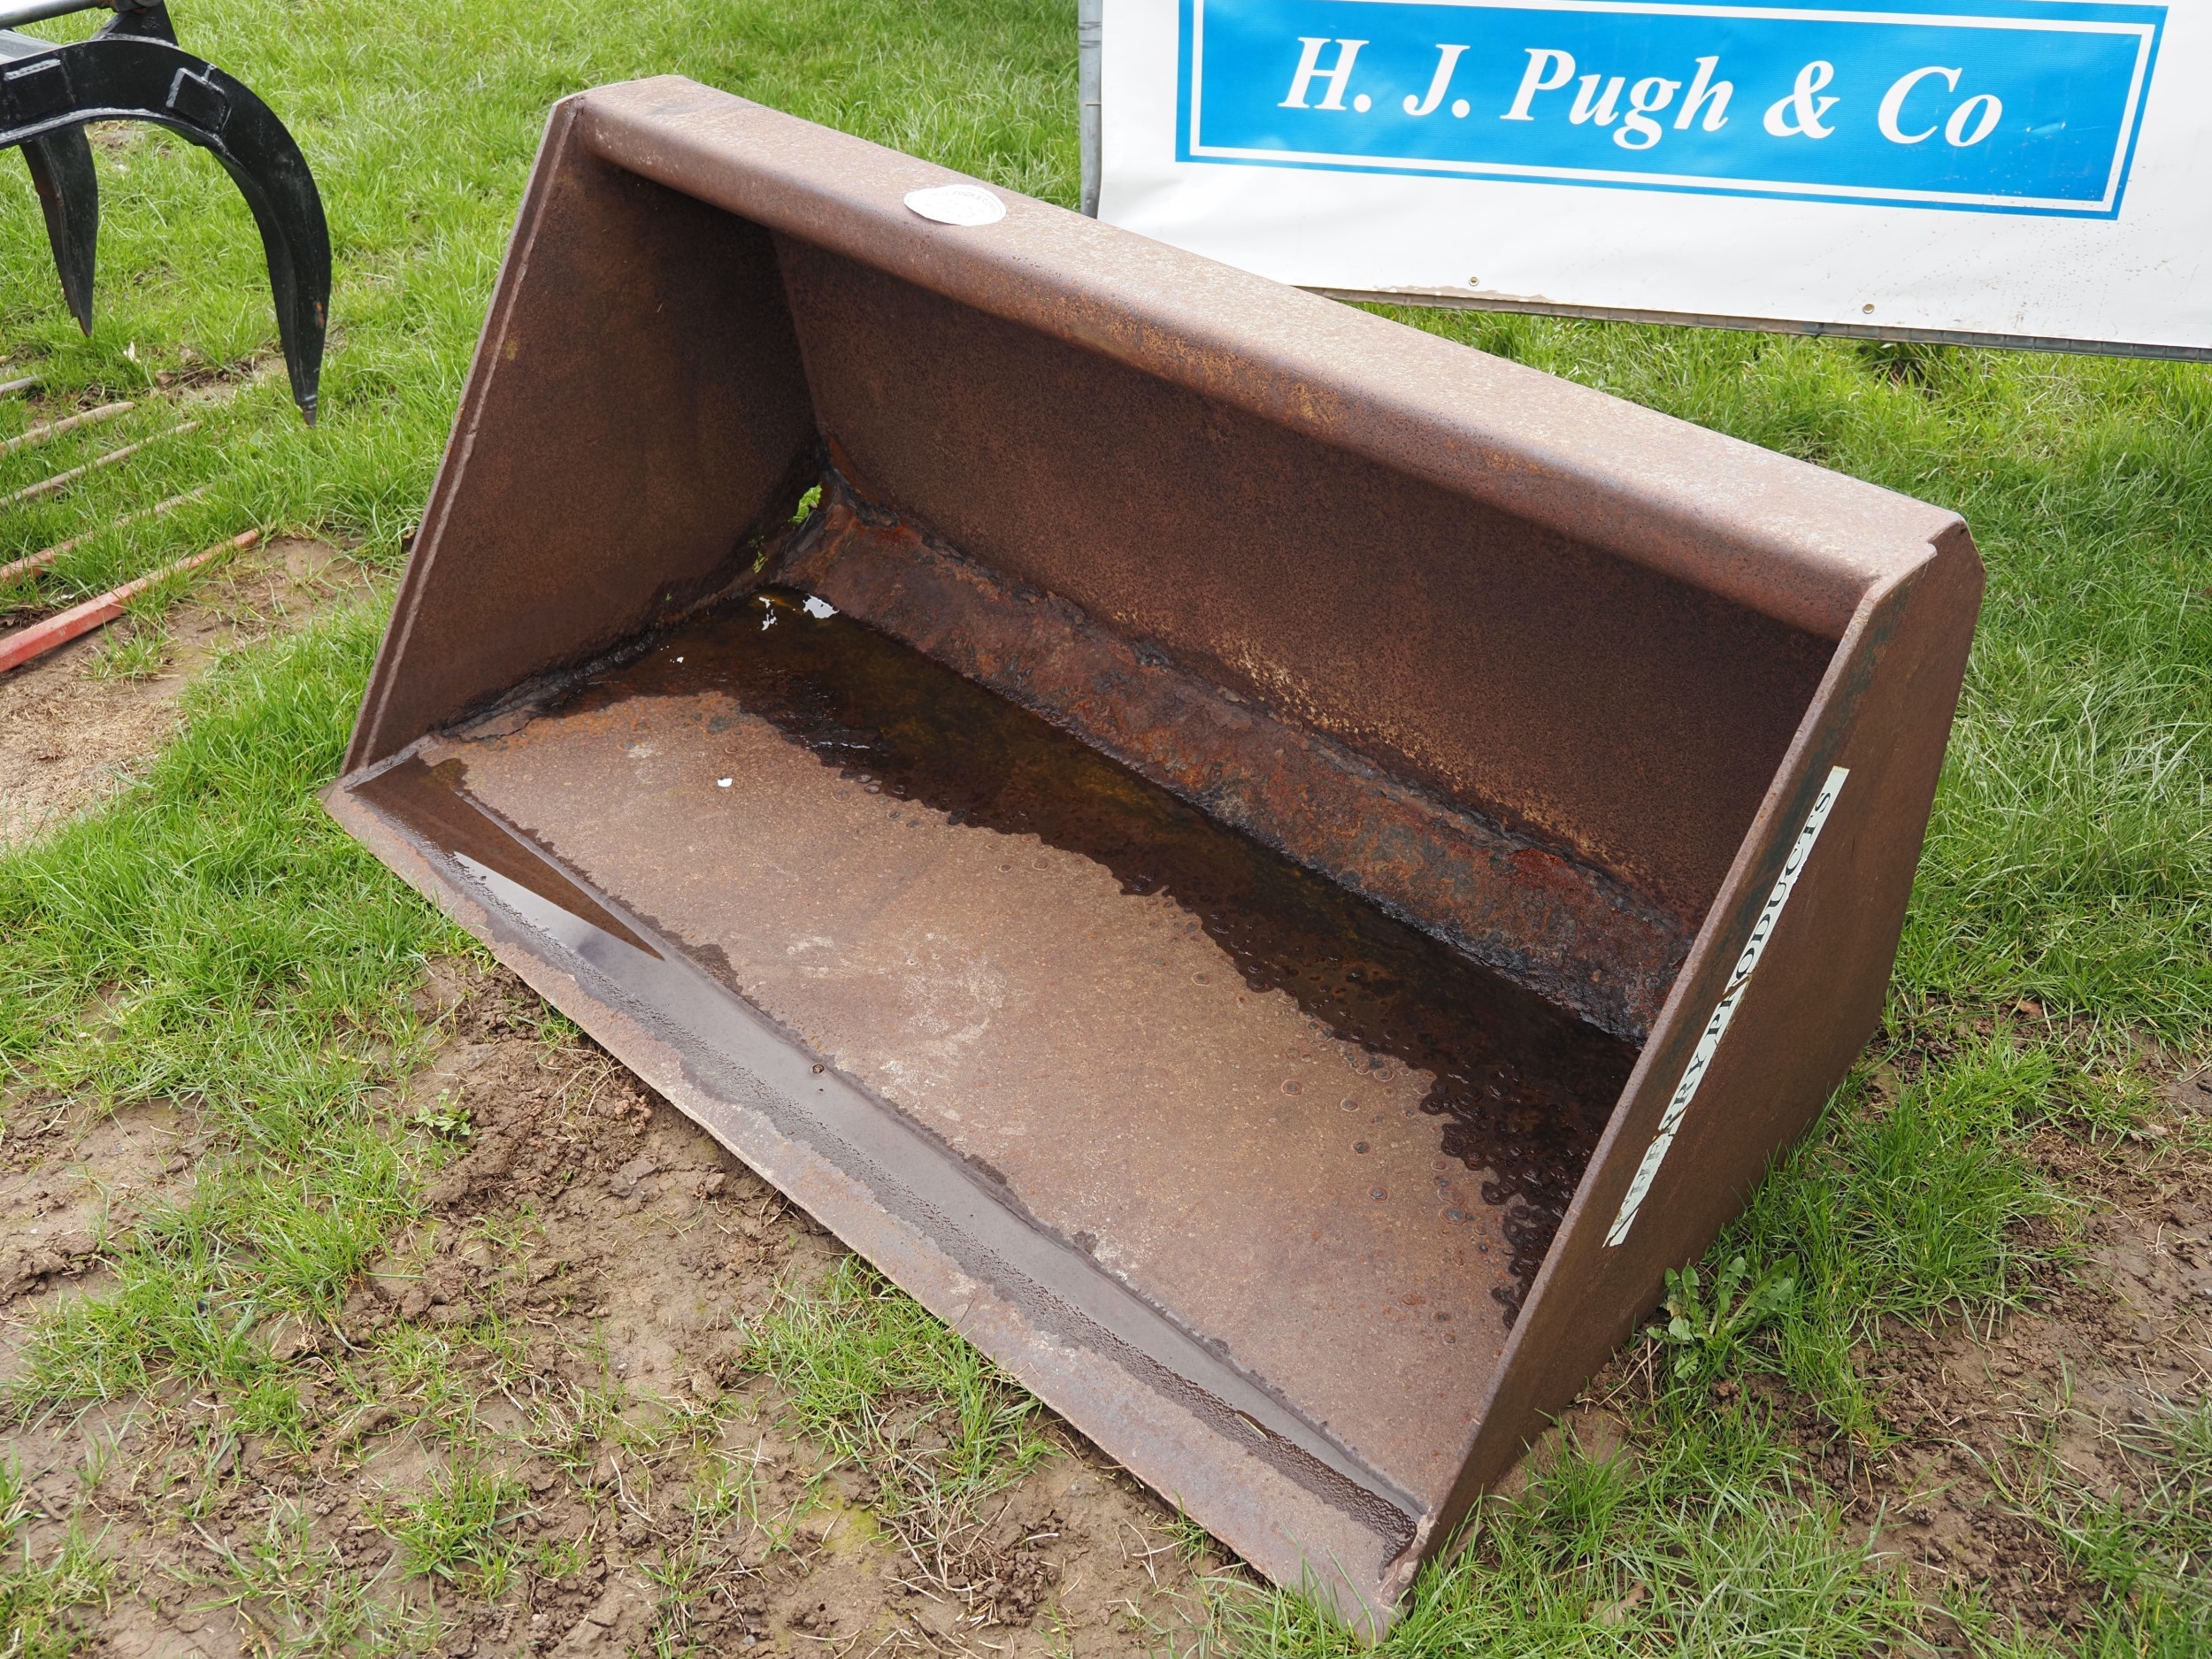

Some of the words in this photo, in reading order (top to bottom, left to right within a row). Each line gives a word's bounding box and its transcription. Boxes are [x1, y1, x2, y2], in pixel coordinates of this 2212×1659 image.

[1278, 36, 1372, 113] H.
[1402, 43, 1471, 119] J.
[1500, 48, 1733, 150] Pugh
[1763, 60, 1840, 140] &
[1878, 65, 2003, 148] Co
